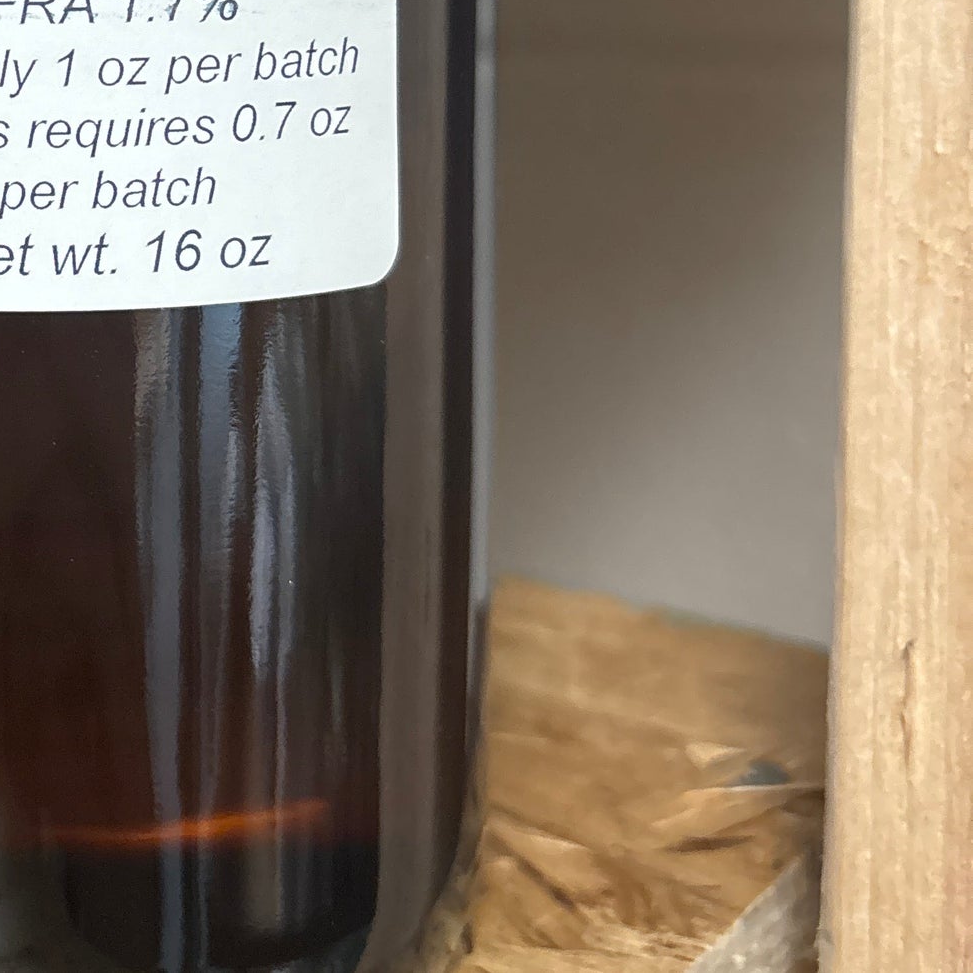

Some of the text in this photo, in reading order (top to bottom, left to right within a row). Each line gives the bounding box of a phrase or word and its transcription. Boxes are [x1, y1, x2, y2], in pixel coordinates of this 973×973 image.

[57, 49, 75, 88] 1
[98, 57, 150, 87] oz
[164, 53, 243, 96] per
[253, 36, 359, 80] batch
[27, 113, 216, 159] requires
[232, 100, 298, 144] 0.7
[310, 105, 352, 137] oz
[91, 166, 217, 211] batch
[51, 237, 119, 276] wt.
[145, 228, 203, 273] 16
[219, 234, 273, 270] oz
